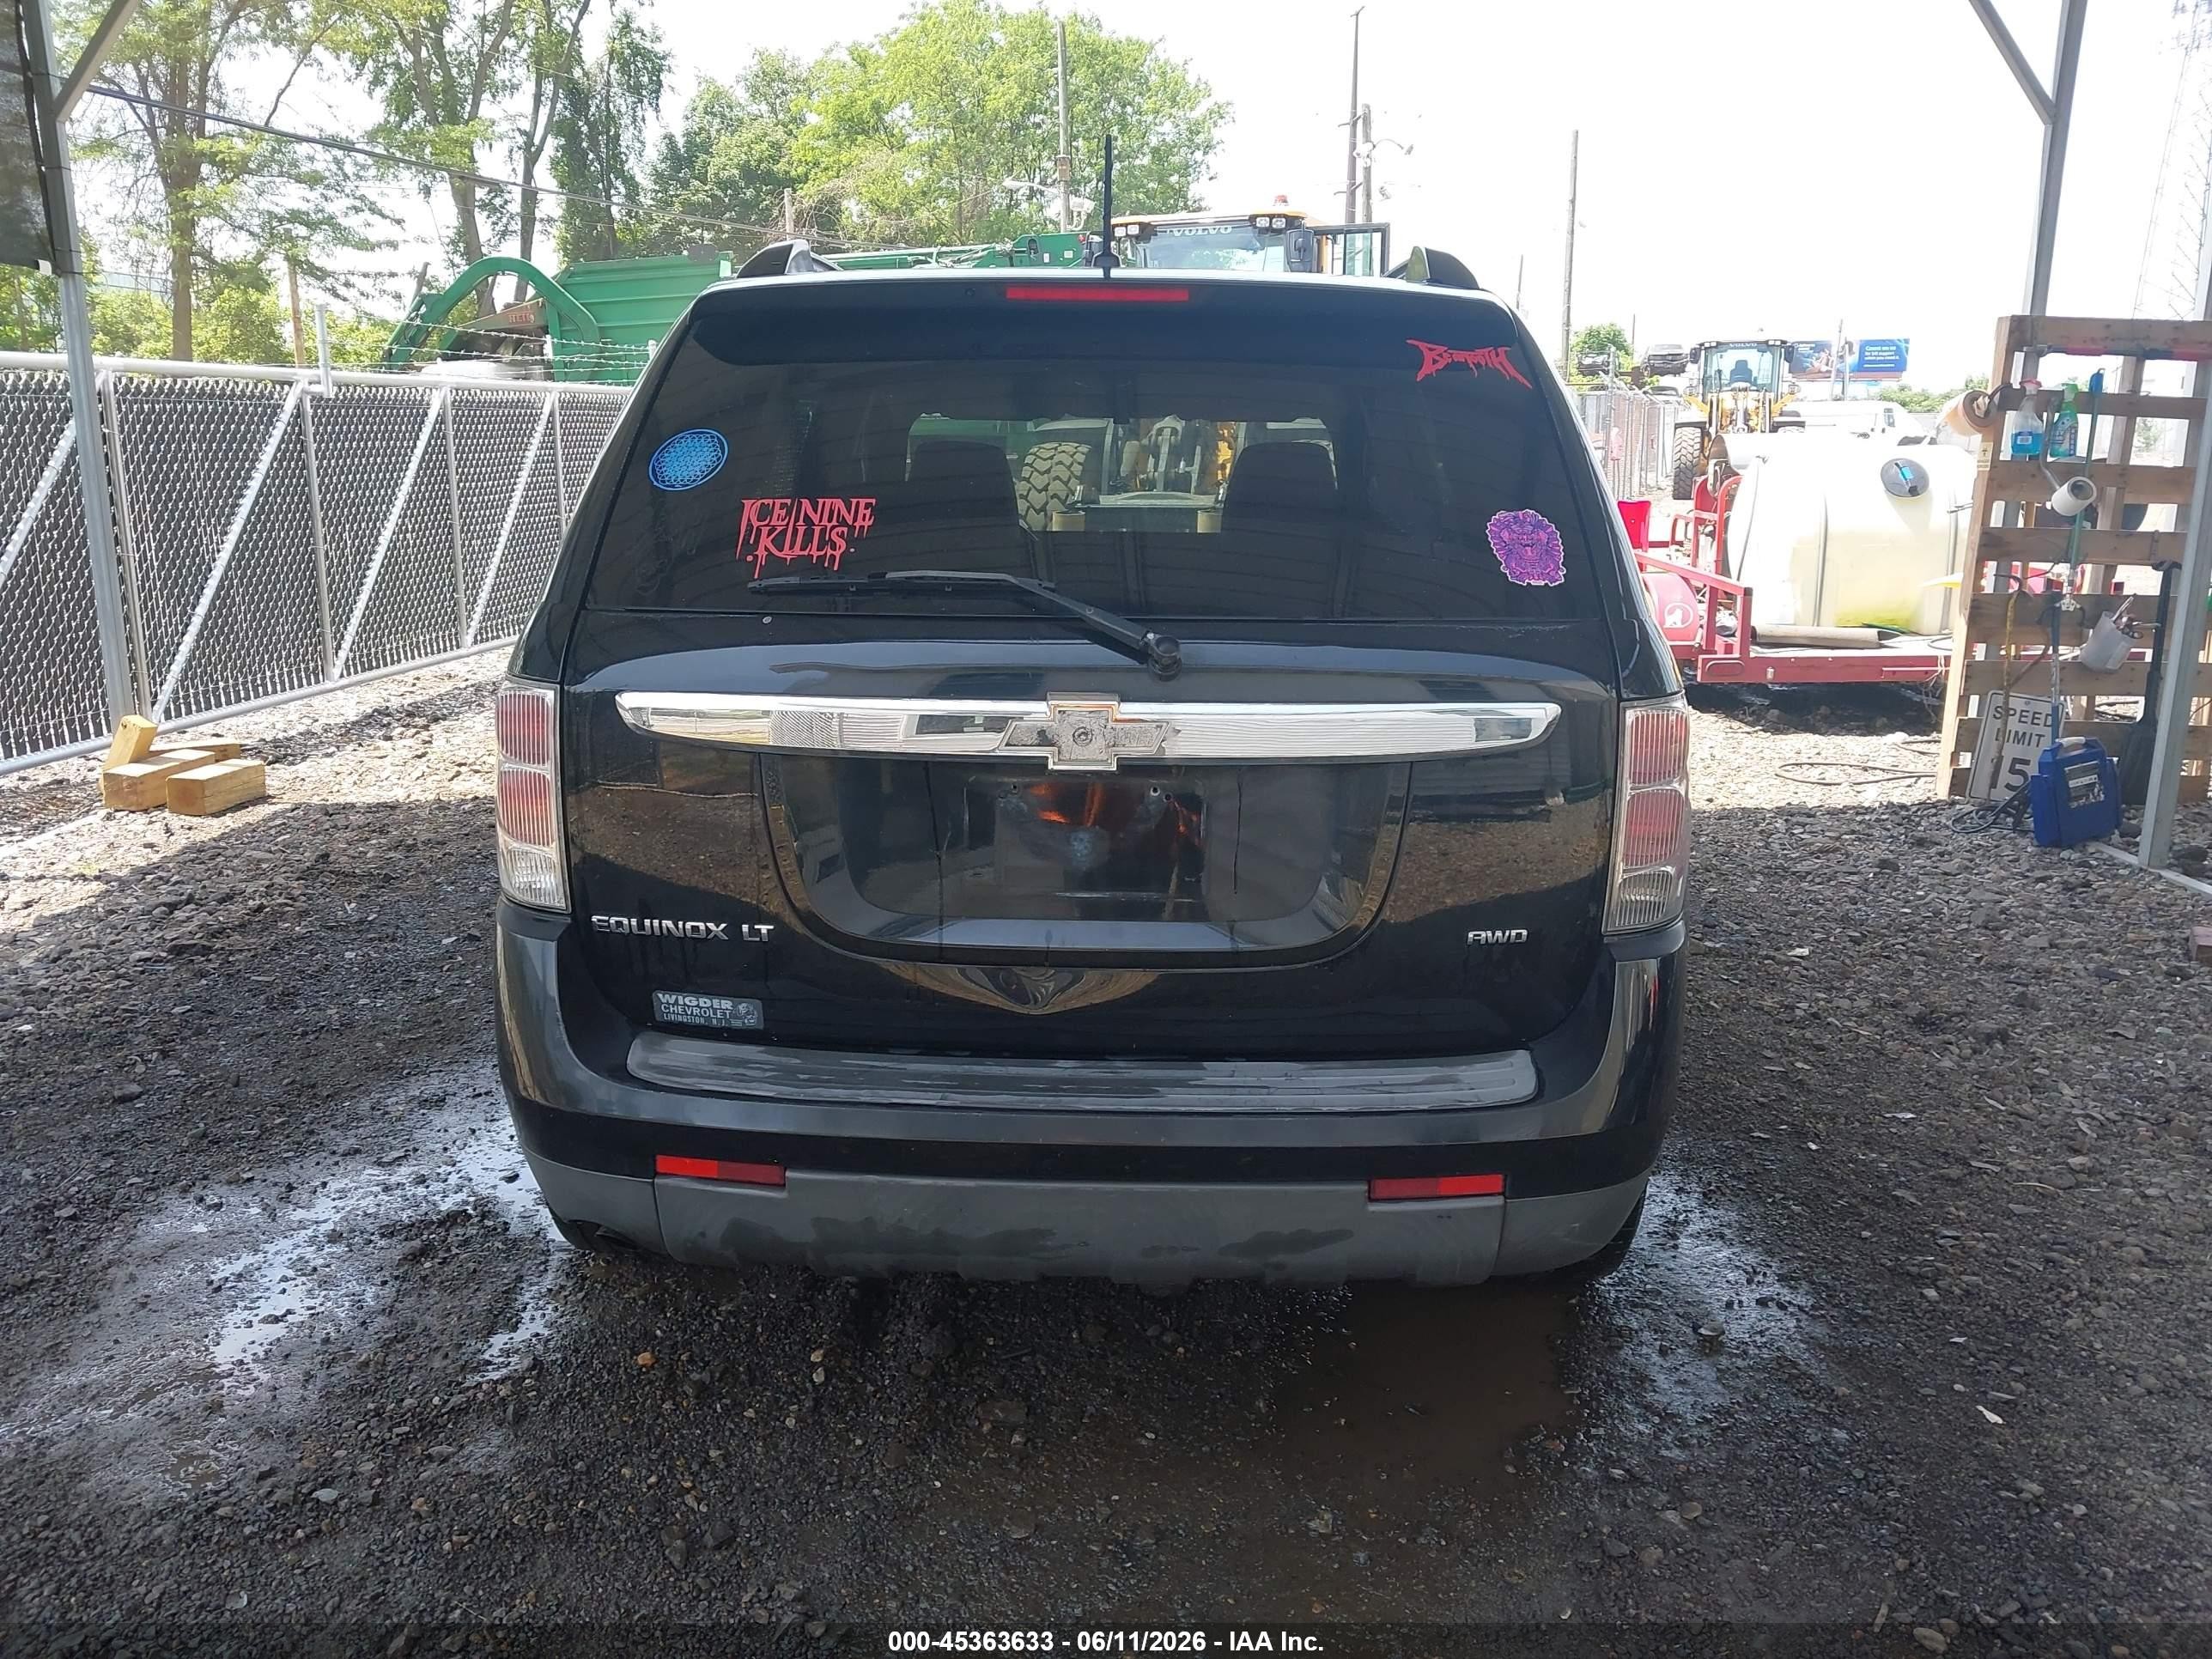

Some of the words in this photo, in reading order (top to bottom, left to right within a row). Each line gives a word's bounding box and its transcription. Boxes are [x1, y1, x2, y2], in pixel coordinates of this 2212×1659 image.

[1173, 226, 1232, 237] VOLVO
[736, 498, 791, 544] ICE
[794, 498, 877, 538] NINE
[754, 526, 848, 572] KILLS
[1993, 706, 2052, 728] SPEED
[1995, 727, 2046, 748] LIMIT
[1990, 756, 2032, 793] 15
[591, 915, 729, 940] EQUINOX
[742, 924, 775, 942] LT
[1467, 929, 1528, 945] AWD
[657, 993, 734, 1010] WIGDER
[661, 1004, 732, 1019] CHEVROLET
